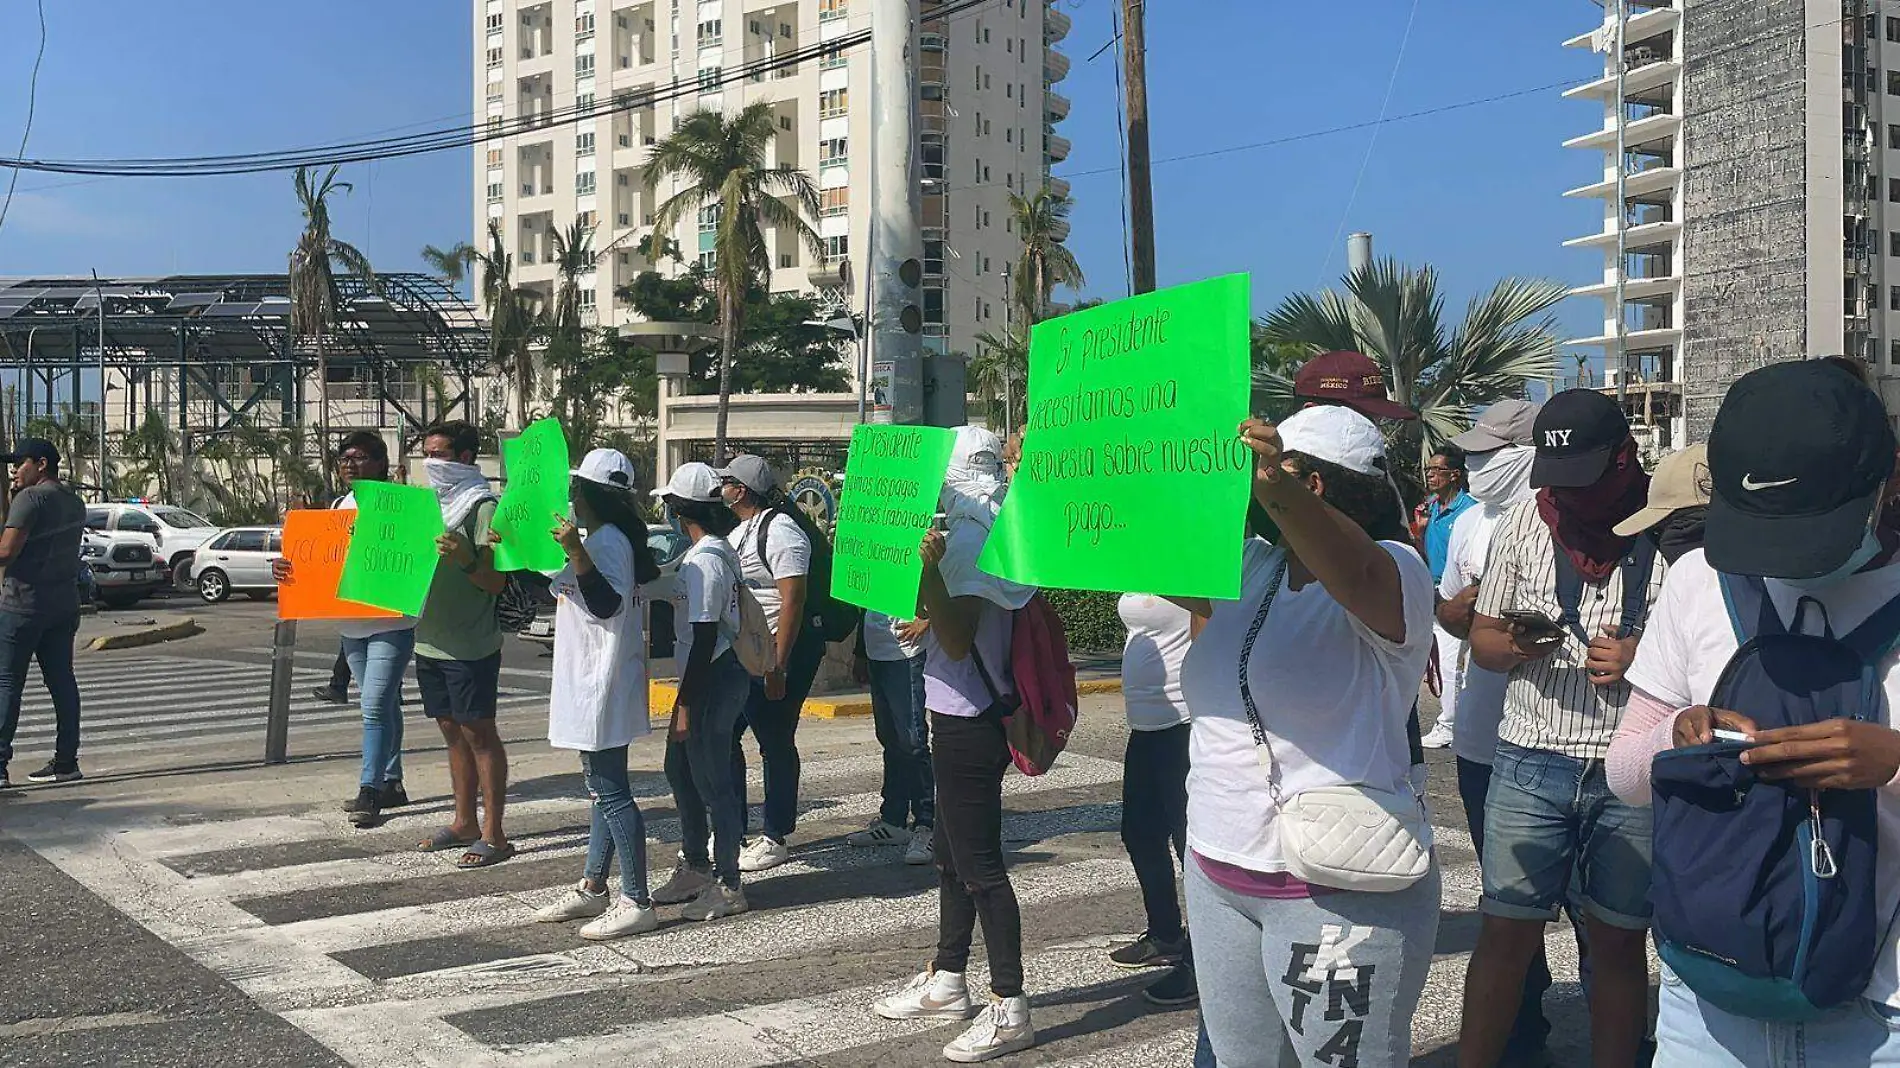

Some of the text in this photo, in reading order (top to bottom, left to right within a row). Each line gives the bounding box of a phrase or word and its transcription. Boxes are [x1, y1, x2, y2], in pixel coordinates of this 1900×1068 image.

[1082, 307, 1171, 369] presidente
[1141, 378, 1178, 413] una
[1161, 428, 1247, 476] nuestro
[1544, 429, 1572, 447] NY
